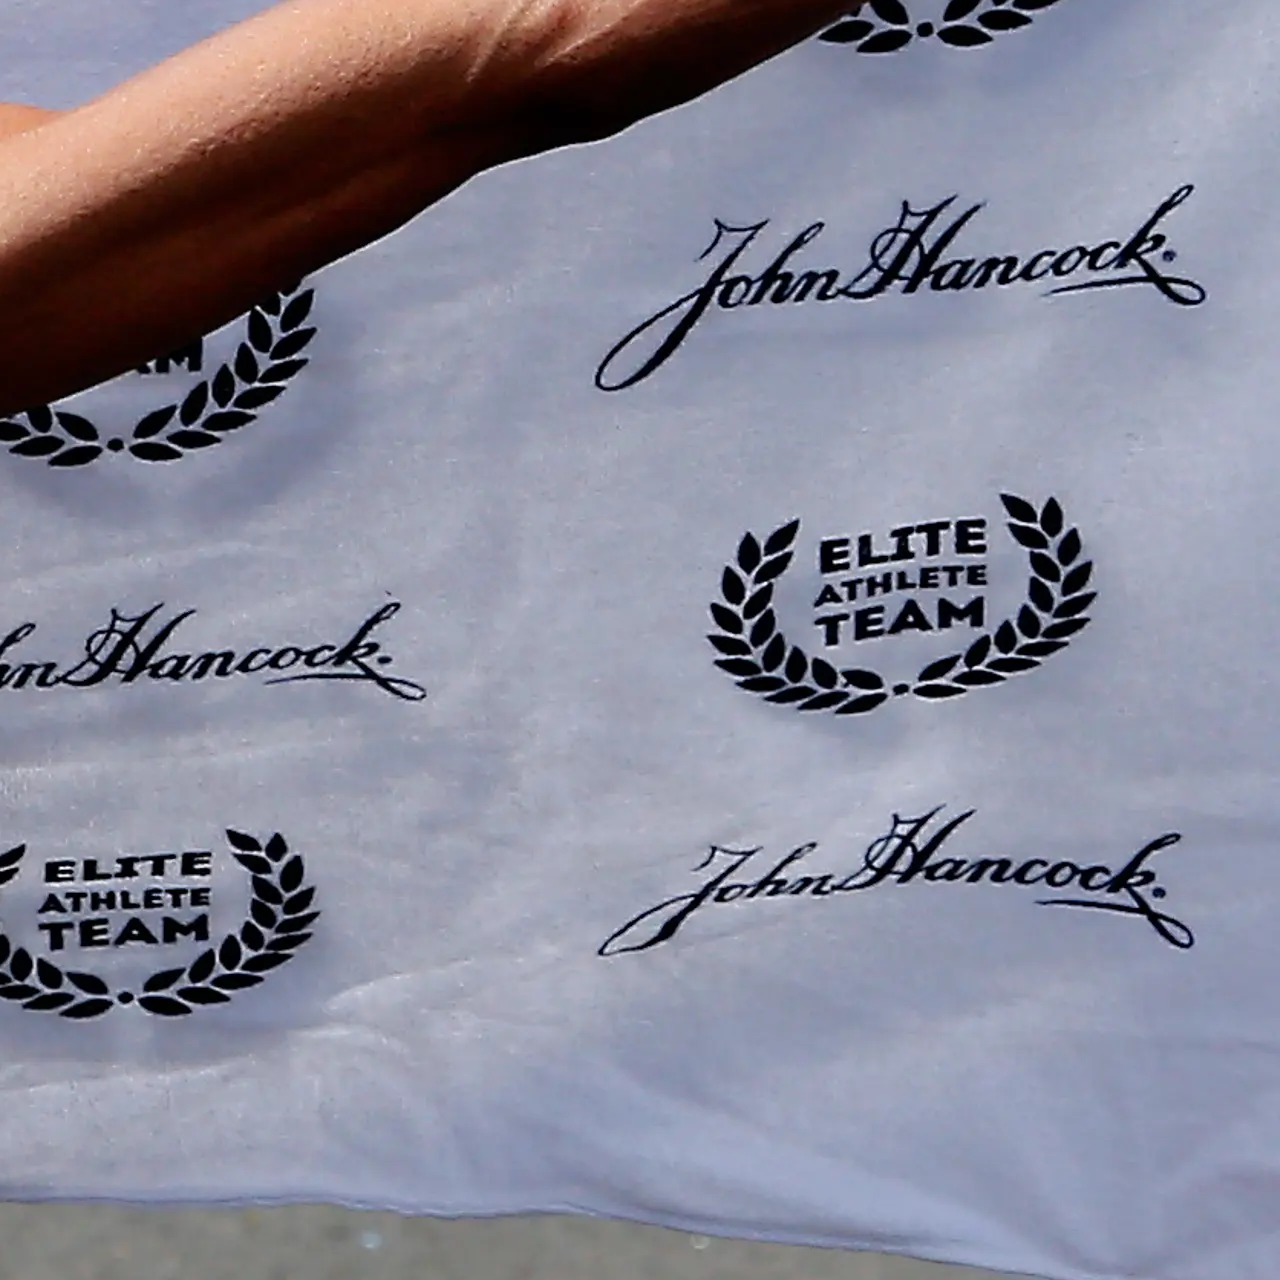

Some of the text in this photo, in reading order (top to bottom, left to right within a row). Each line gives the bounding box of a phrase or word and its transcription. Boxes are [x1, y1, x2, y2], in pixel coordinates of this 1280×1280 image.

[595, 184, 1206, 392] John Hancock
[819, 518, 988, 576] ELITE
[813, 565, 988, 609] ATHLETE
[814, 596, 986, 648] TEAM
[56, 602, 427, 701] Hancock
[44, 851, 213, 884] ELITE
[598, 803, 1194, 956] John Hancock
[37, 883, 212, 915] ATHLETE
[37, 914, 210, 951] TEAM
